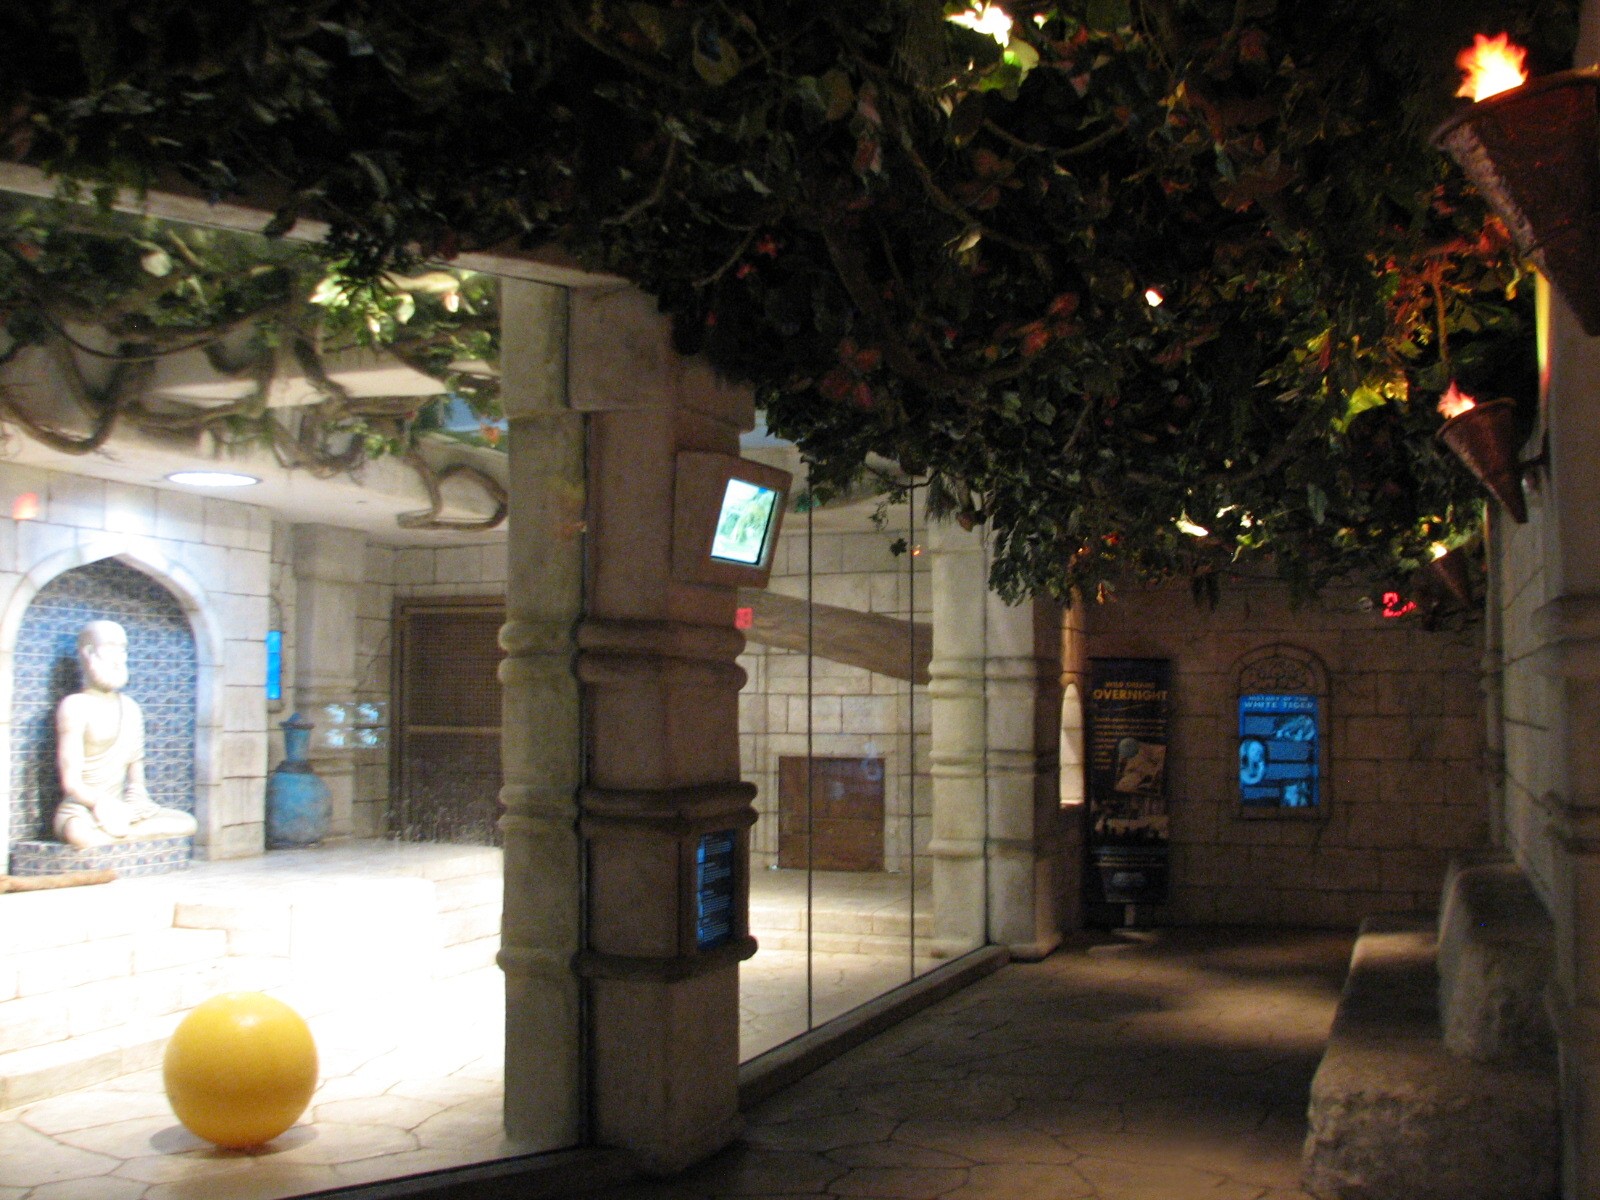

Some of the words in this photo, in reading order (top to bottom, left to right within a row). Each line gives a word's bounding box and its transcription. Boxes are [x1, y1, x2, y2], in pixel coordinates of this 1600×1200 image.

[1092, 689, 1168, 701] OVERNIGHT
[1244, 701, 1278, 709] WHITE
[1282, 701, 1314, 709] TIGER
